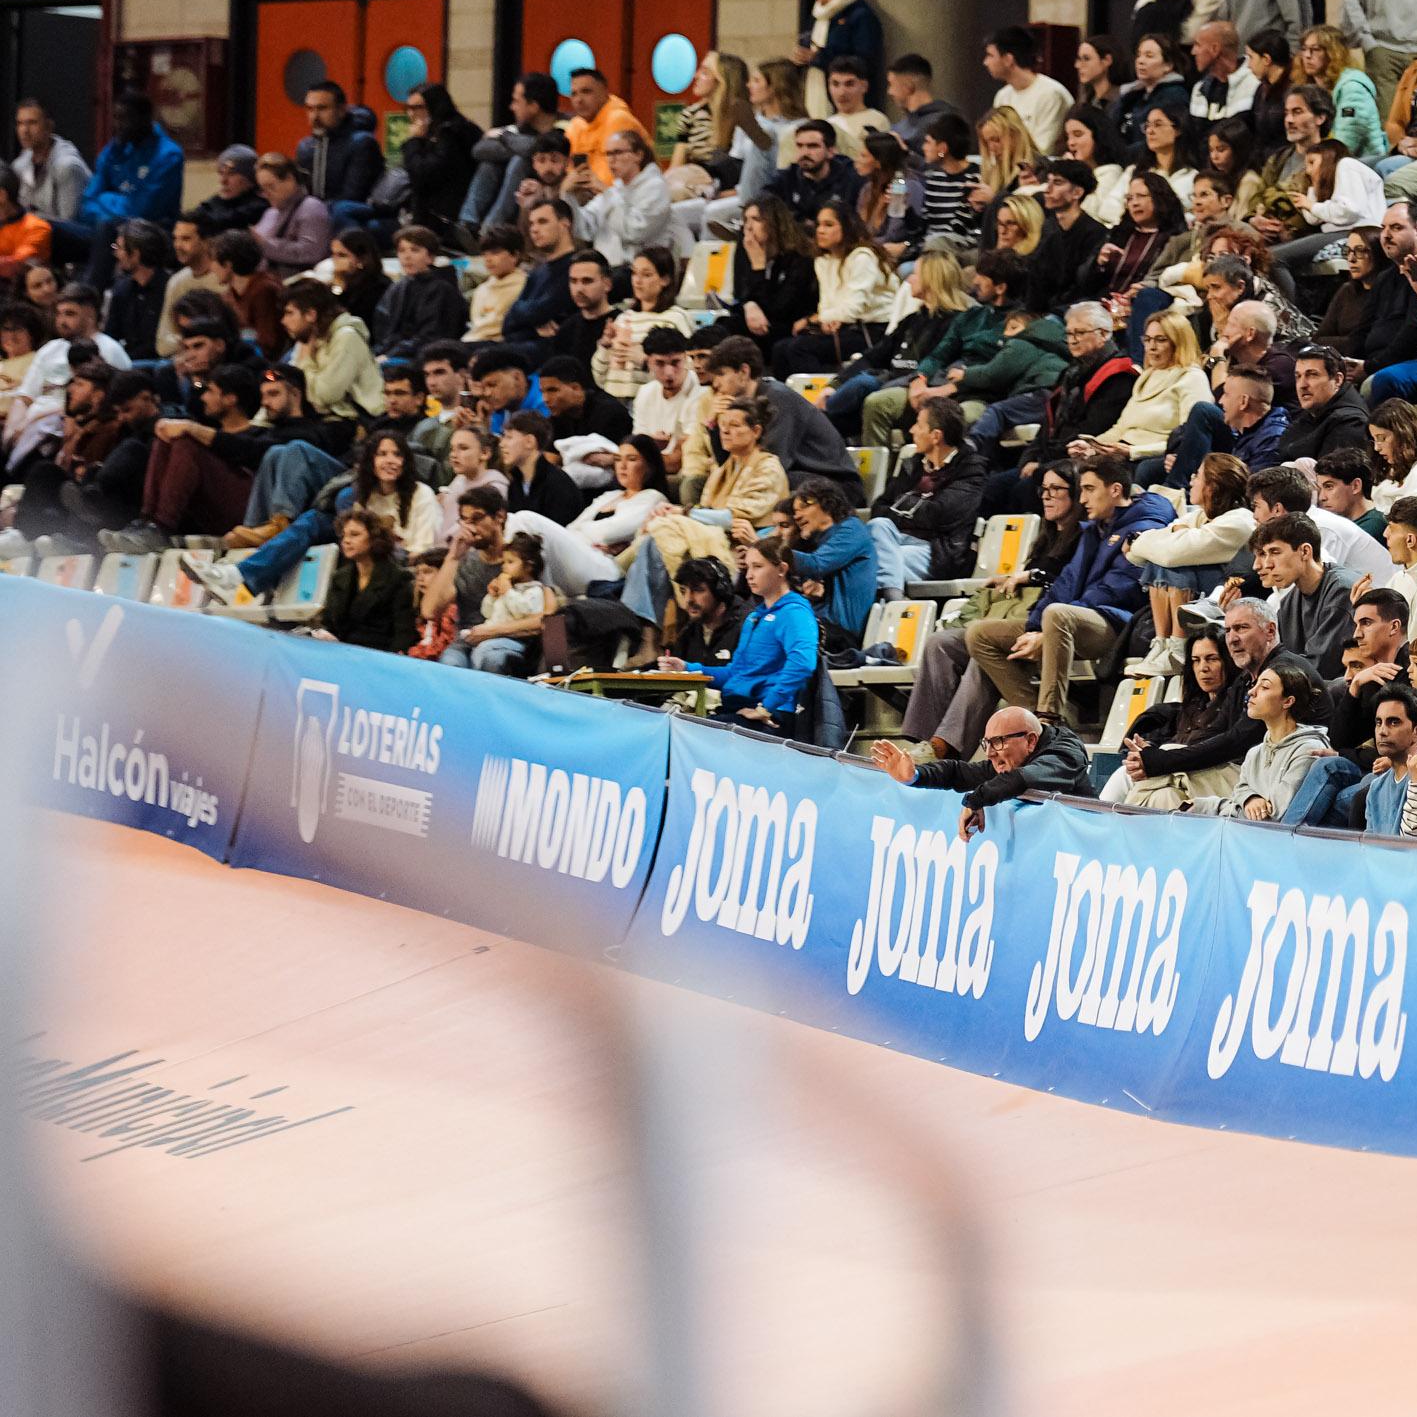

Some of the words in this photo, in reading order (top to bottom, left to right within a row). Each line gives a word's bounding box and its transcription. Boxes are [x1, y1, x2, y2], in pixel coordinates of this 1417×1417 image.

[53, 713, 169, 808] Halcón
[170, 771, 219, 828] viajes
[338, 706, 443, 775] LOTERÍAS
[498, 758, 647, 889] MONDO
